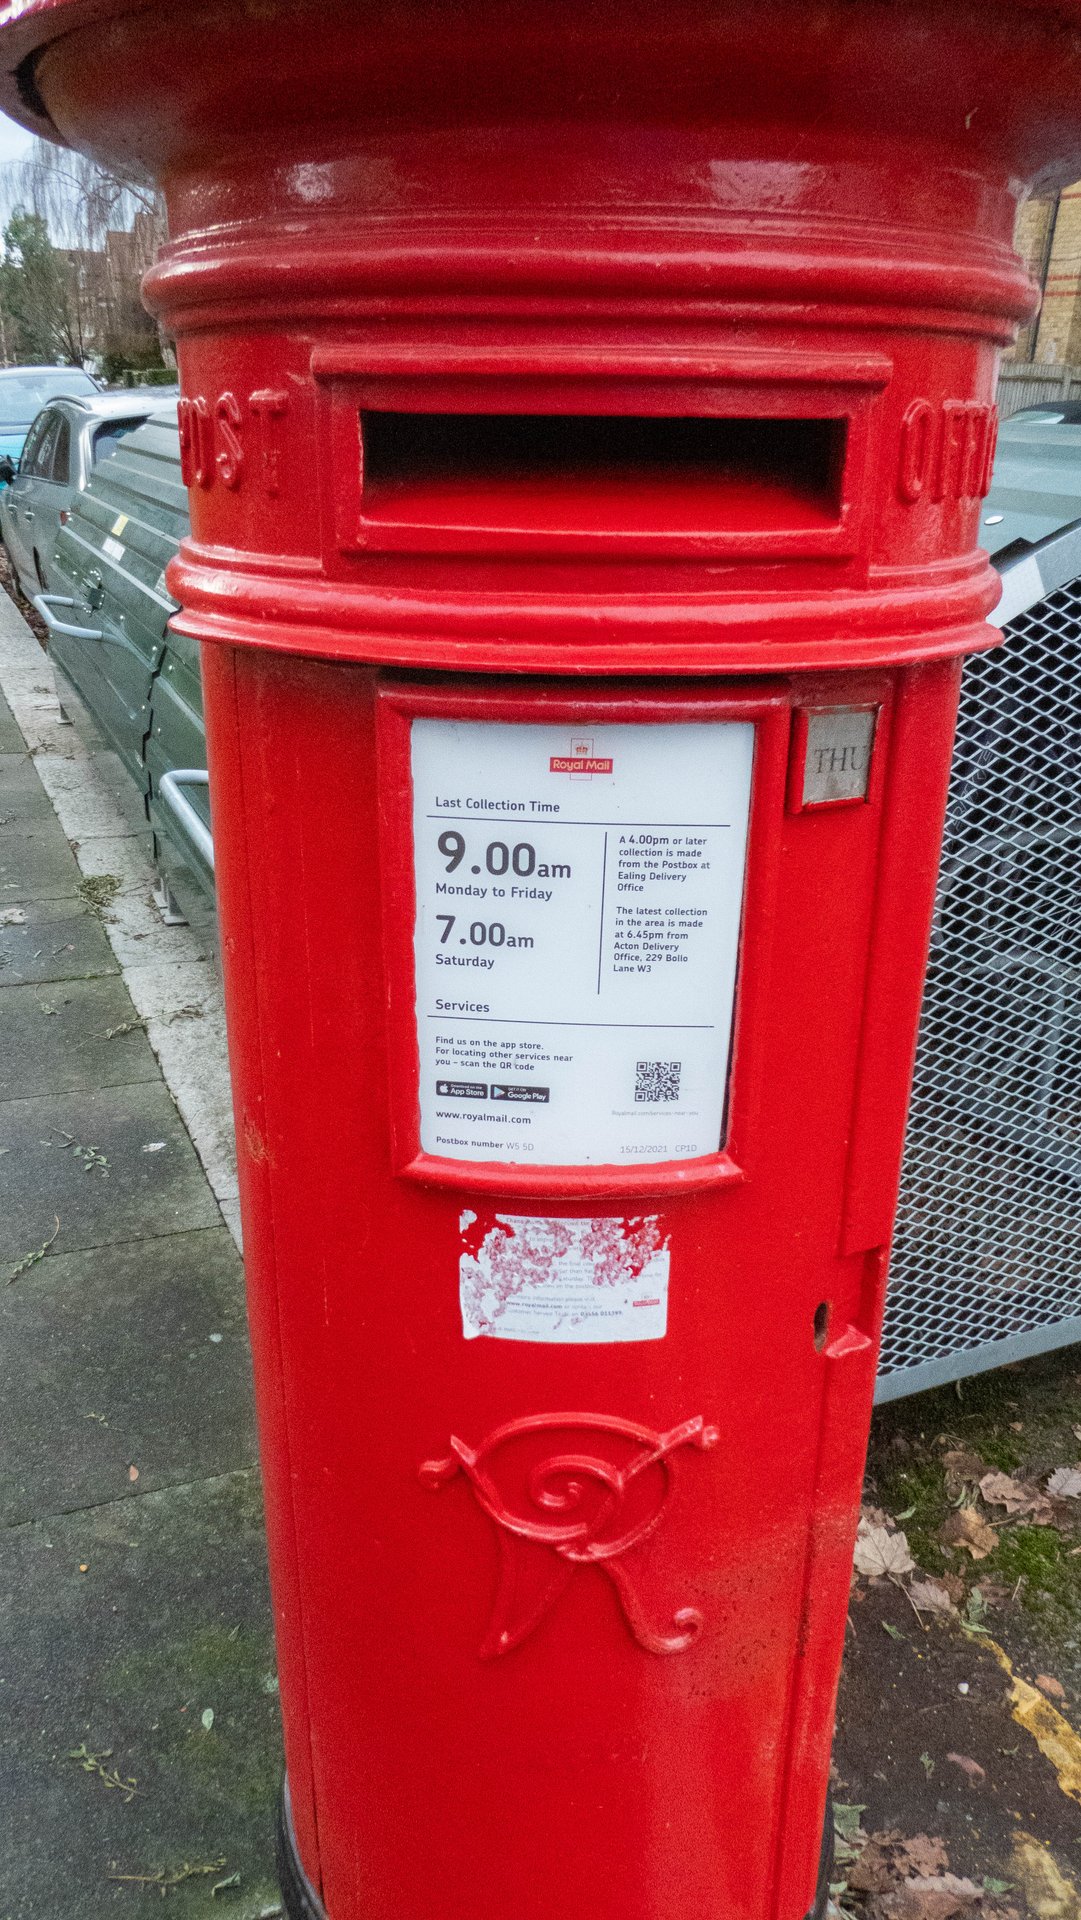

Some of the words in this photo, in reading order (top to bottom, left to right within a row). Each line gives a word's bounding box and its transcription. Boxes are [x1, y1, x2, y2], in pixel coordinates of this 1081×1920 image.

[813, 744, 868, 774] THU
[552, 759, 584, 772] Royal
[586, 760, 610, 770] Mail
[435, 796, 462, 808] Last
[466, 798, 525, 811] Collection
[529, 801, 560, 812] Time
[619, 836, 626, 844] A
[628, 834, 669, 846] 4.00pm
[686, 837, 707, 845] later
[438, 830, 571, 878] 9.00am
[619, 848, 662, 856] collection
[618, 859, 640, 868] from
[662, 860, 698, 869] Postbox
[618, 871, 646, 882] Ealing
[649, 872, 686, 882] Delivery
[436, 883, 488, 899] Monday
[492, 886, 506, 898] to
[511, 888, 552, 903] Friday
[618, 883, 644, 892] Office
[616, 906, 633, 915] The
[636, 907, 662, 915] latest
[665, 908, 708, 916] collection
[668, 919, 675, 927] is
[436, 914, 534, 948] 7.00am
[627, 930, 664, 940] 6.45pm
[667, 931, 688, 939] from
[614, 942, 639, 950] Acton
[642, 942, 679, 952] Delivery
[436, 954, 494, 972] Saturday
[614, 953, 642, 962] Office,
[646, 954, 662, 962] 229
[666, 954, 688, 962] Bollo
[613, 964, 634, 972] Lane
[436, 999, 490, 1013] Services
[435, 1036, 454, 1044] Find
[501, 1042, 516, 1050] app
[519, 1042, 544, 1050] store.
[452, 1048, 486, 1058] locating
[515, 1052, 550, 1061] services
[500, 1062, 512, 1070] QR
[508, 1092, 531, 1100] Google
[532, 1092, 546, 1101] Play
[436, 1111, 531, 1124] www.royalmail.com
[436, 1136, 468, 1146] Postbox
[471, 1140, 504, 1149] number
[506, 1142, 520, 1150] W5
[620, 1145, 667, 1154] 15/12/2021
